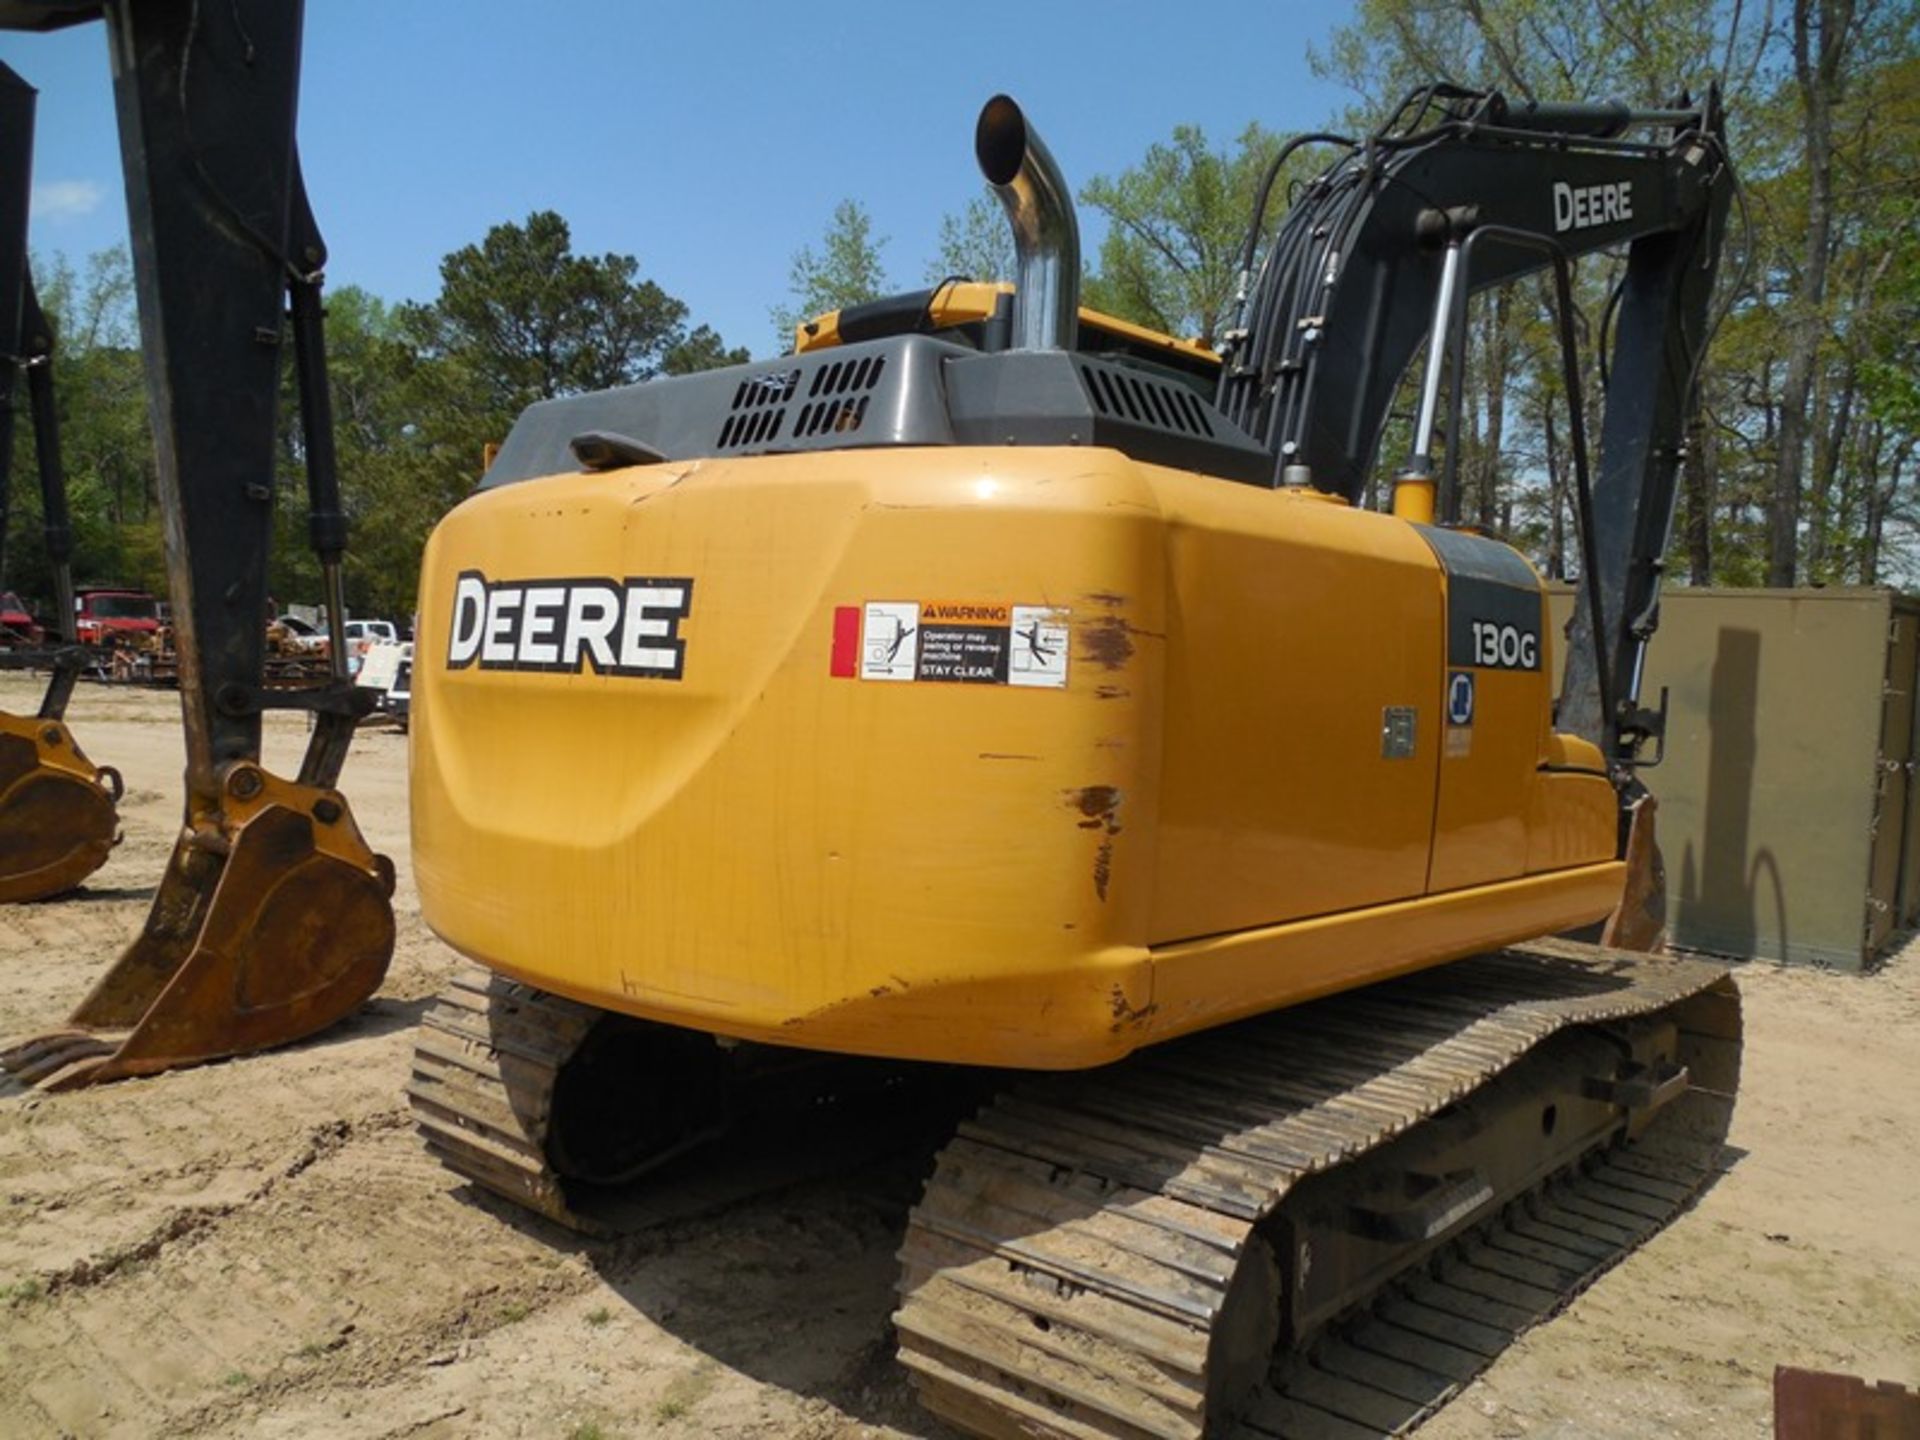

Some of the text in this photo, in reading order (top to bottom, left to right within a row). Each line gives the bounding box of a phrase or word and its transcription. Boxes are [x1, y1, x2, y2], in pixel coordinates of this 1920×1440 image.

[1554, 181, 1633, 231] DEERE
[938, 606, 1007, 621] WARNING
[450, 578, 684, 669] DEERE
[923, 631, 987, 644] Operator may
[923, 642, 1000, 653] swing or reverse
[1473, 622, 1535, 668] 130G
[922, 652, 962, 661] machine
[921, 664, 994, 677] STAY CLEAR
